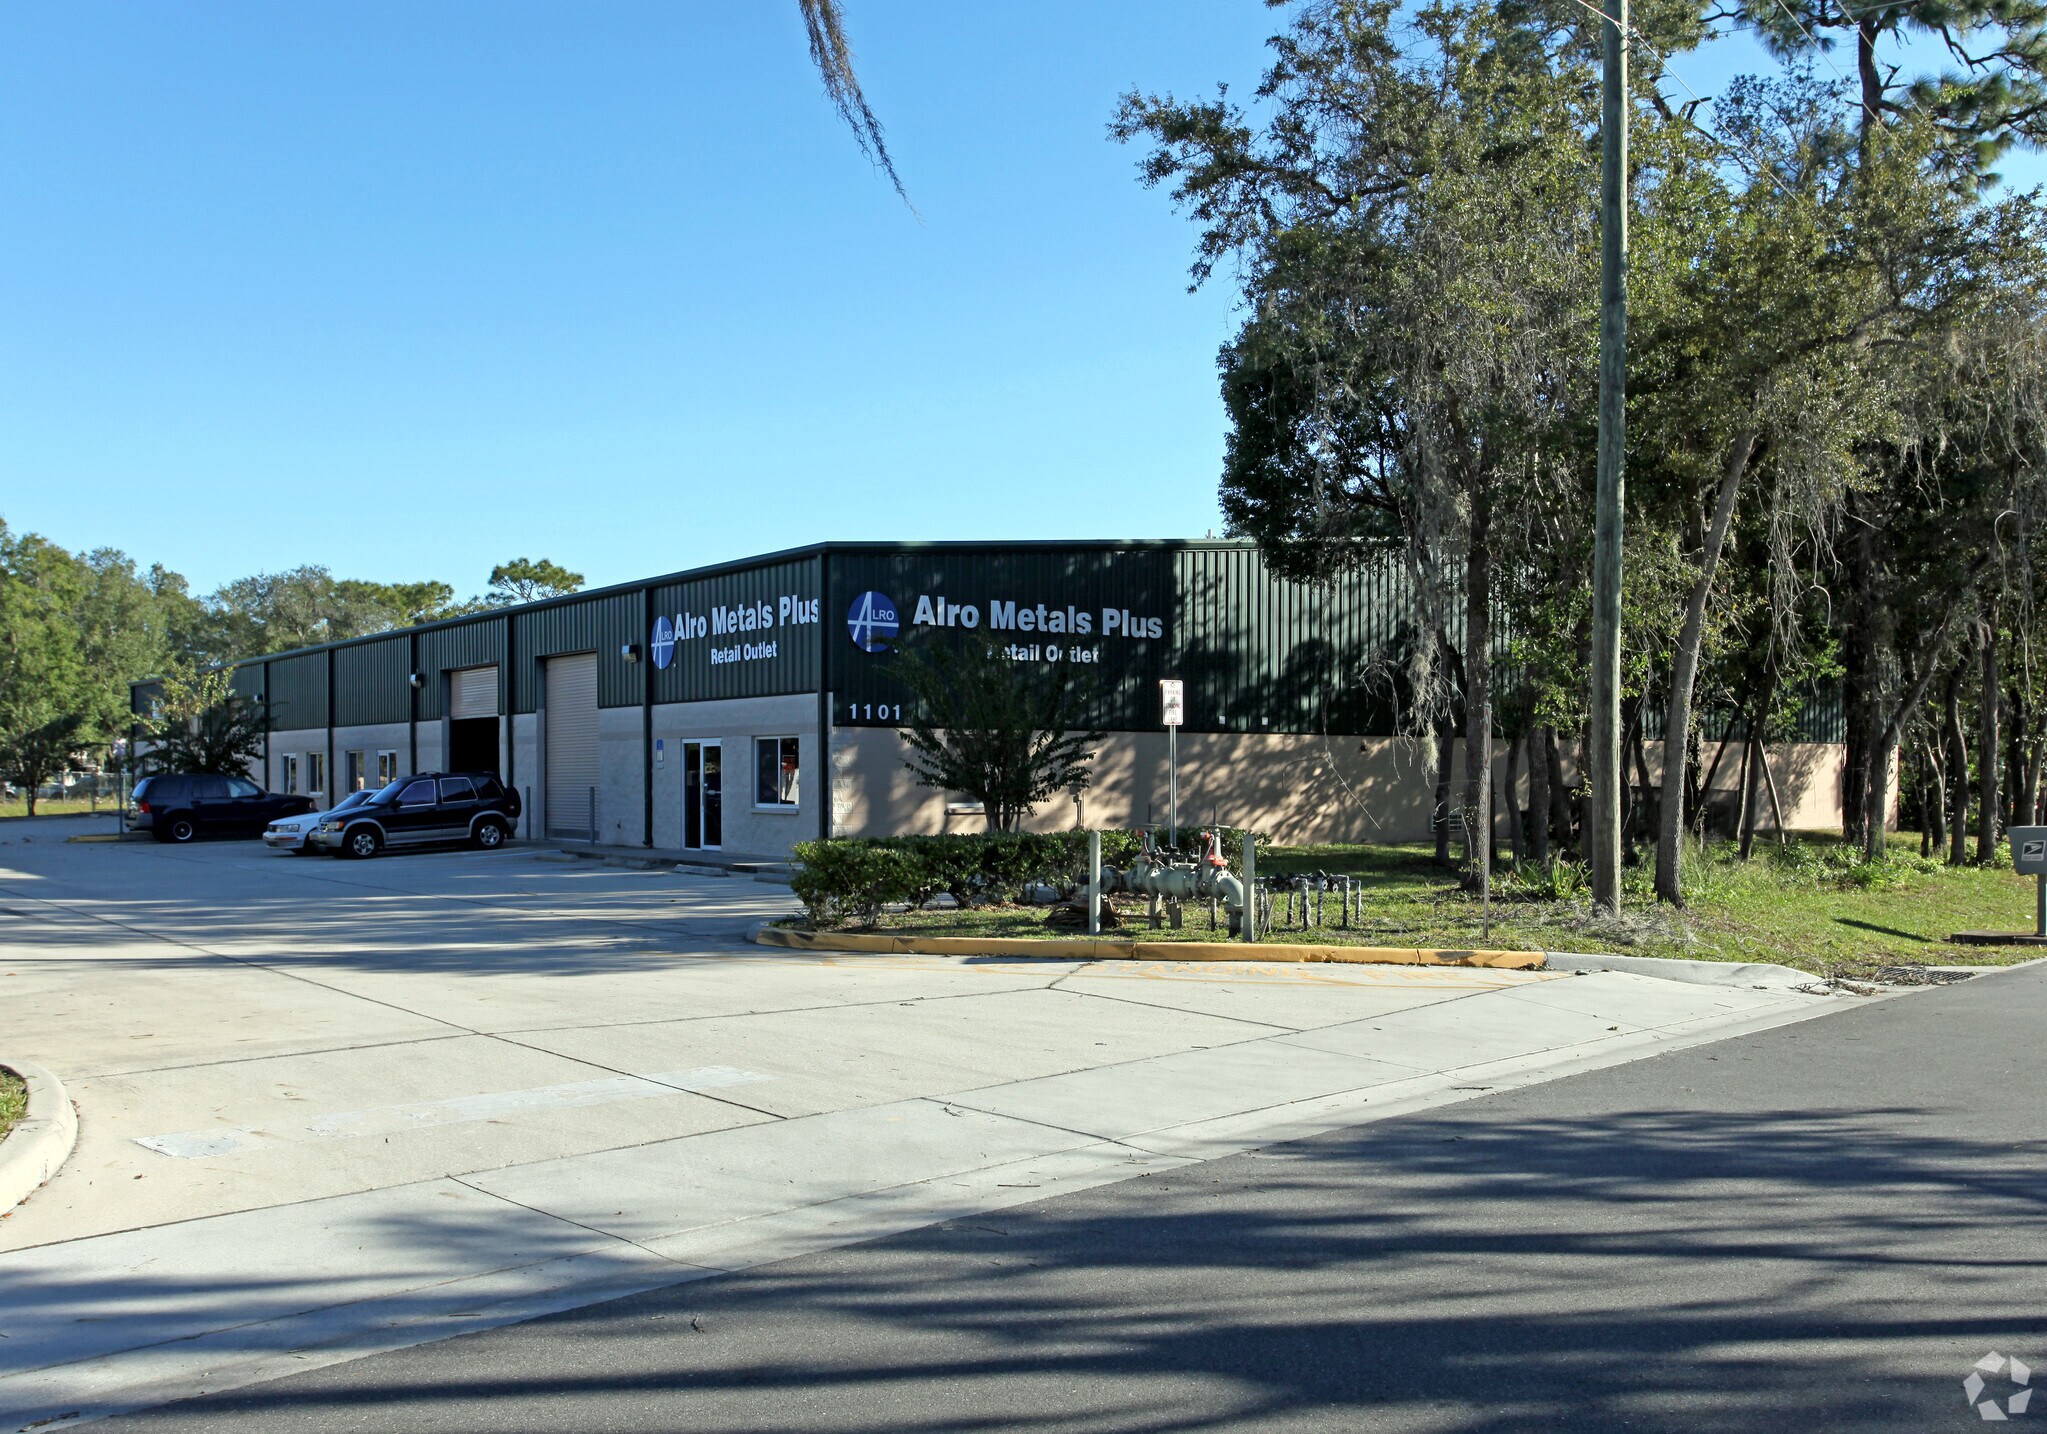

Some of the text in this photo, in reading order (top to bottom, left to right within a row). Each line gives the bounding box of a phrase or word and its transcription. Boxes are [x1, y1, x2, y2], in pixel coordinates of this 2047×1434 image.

[674, 594, 819, 641] Alro Metals Plus
[913, 595, 1163, 639] Alro Metals Plus
[711, 640, 777, 664] Retail Outlet
[987, 643, 1040, 661] etail
[849, 703, 900, 720] 1101
